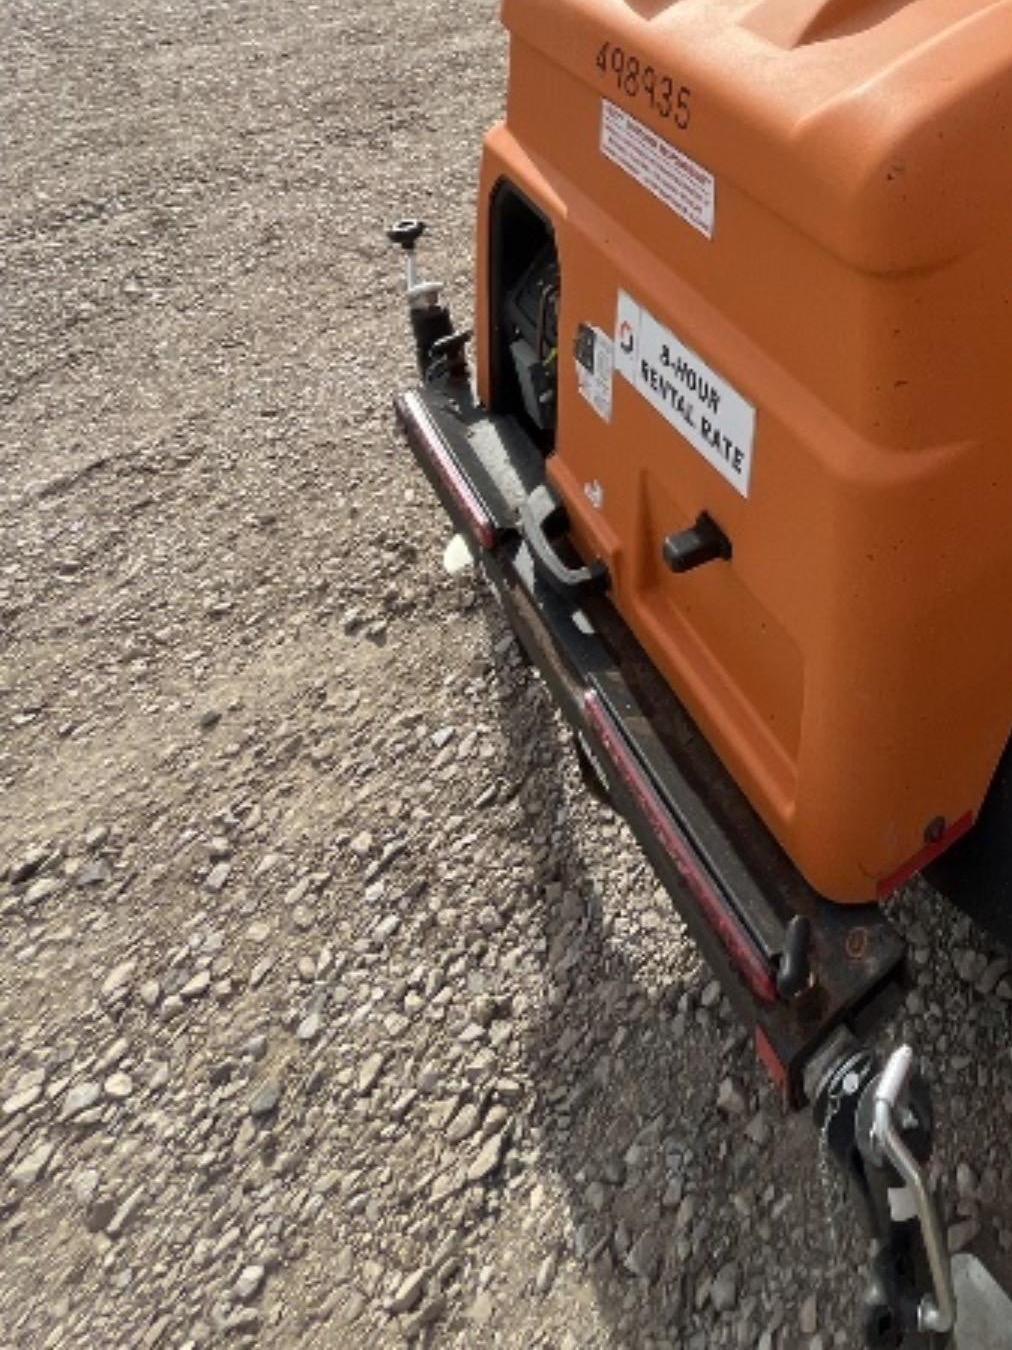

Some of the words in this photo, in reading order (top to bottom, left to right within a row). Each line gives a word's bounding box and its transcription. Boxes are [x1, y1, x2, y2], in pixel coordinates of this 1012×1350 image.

[596, 41, 691, 130] 498935
[640, 359, 696, 428] RENTAL
[700, 415, 746, 474] RATE
[659, 344, 721, 415] 8-HOUR
